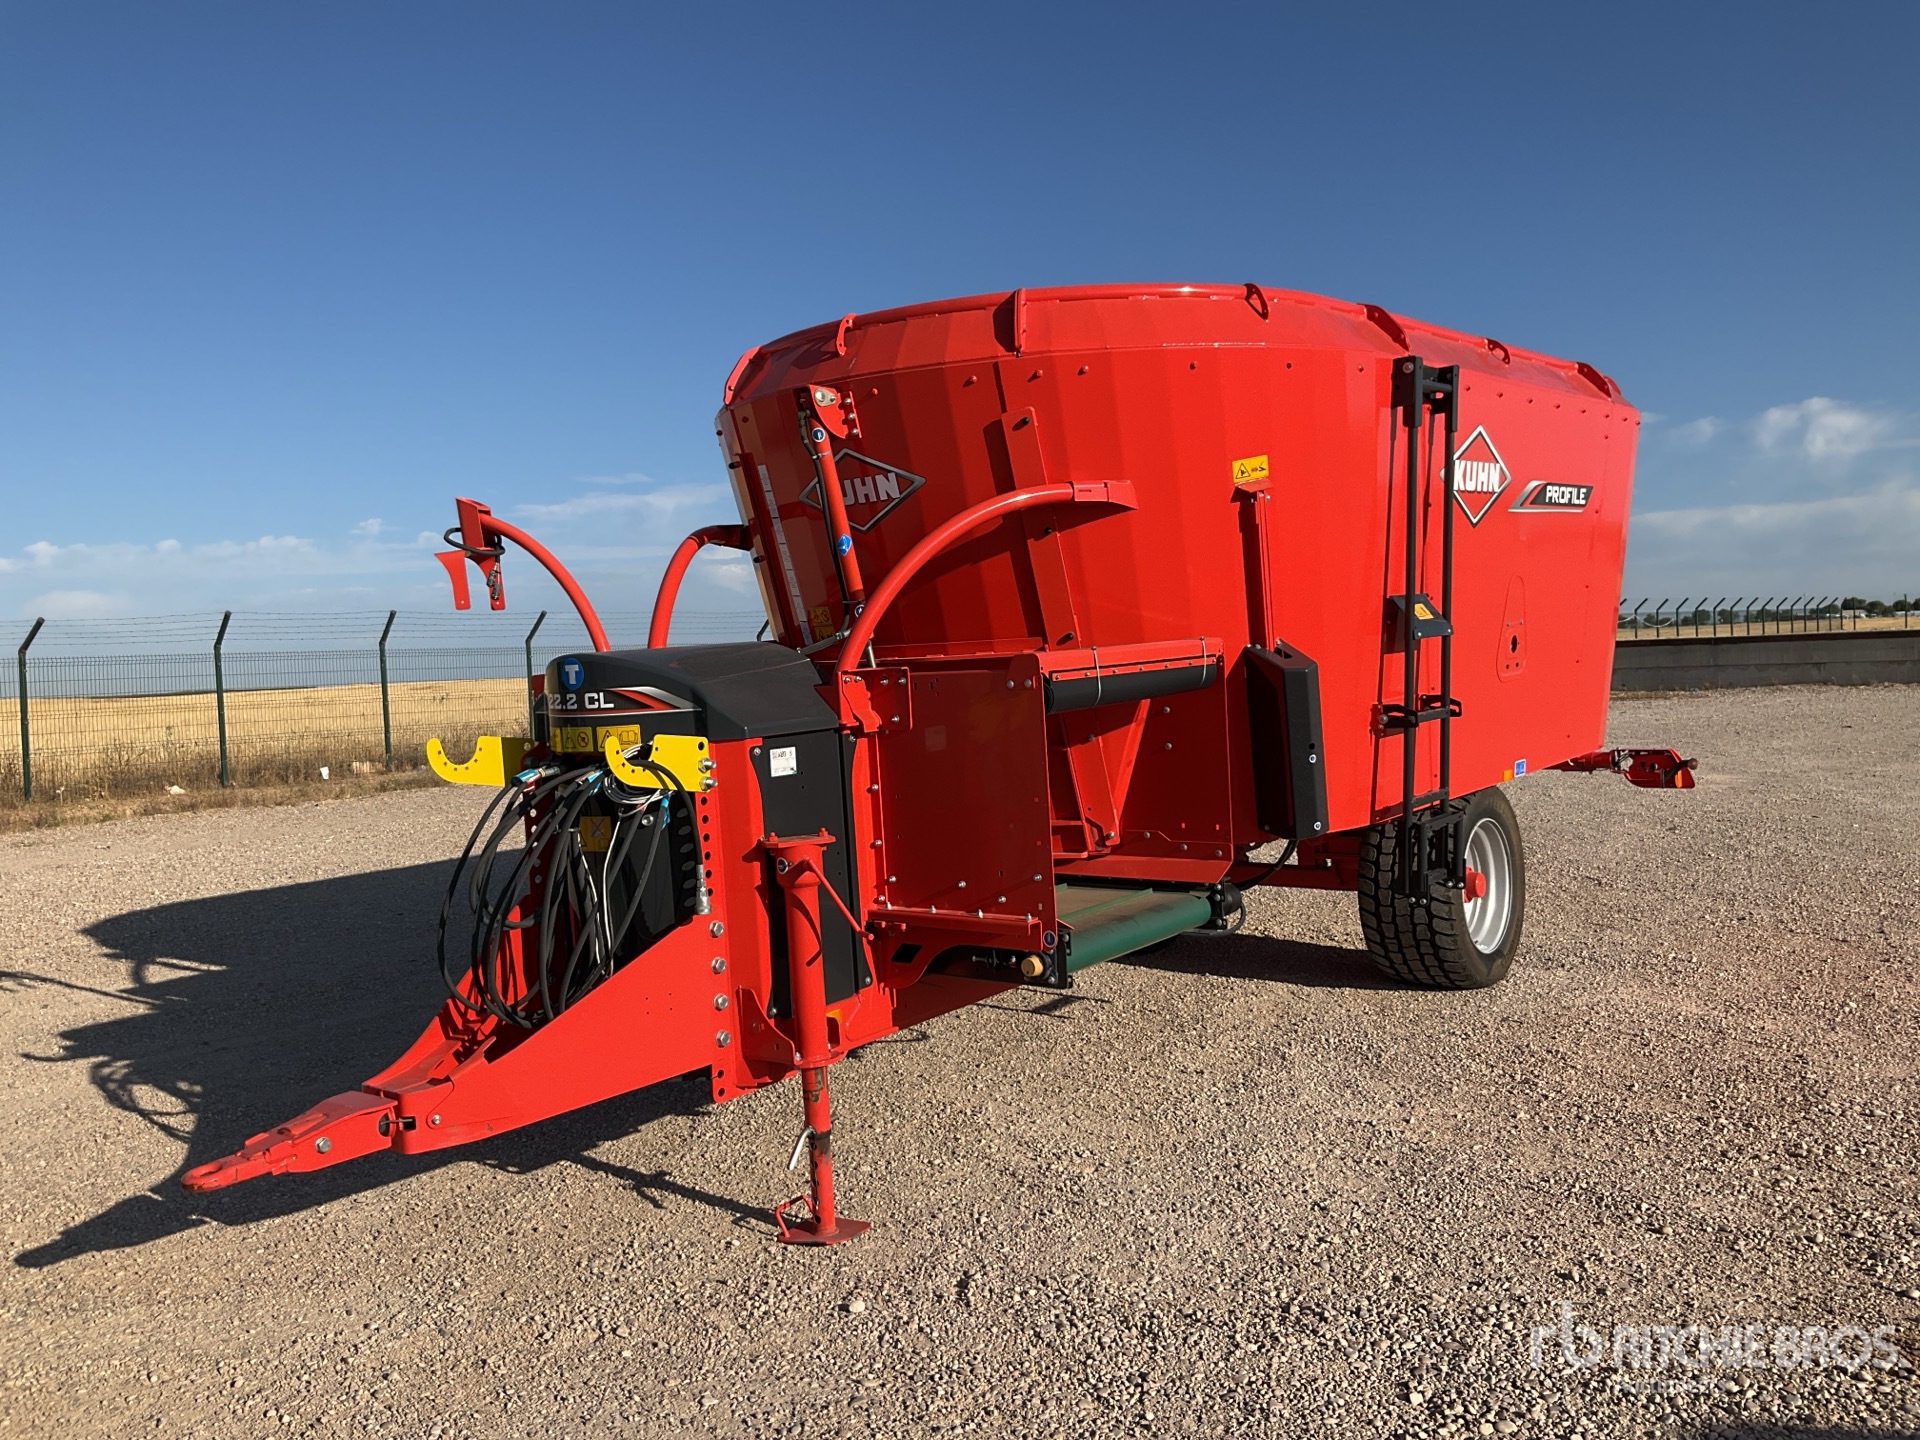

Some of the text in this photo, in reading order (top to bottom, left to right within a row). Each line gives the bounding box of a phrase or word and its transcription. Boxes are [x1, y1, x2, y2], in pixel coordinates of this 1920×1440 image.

[1453, 459, 1501, 493] KUHN
[816, 472, 901, 506] UHN
[1545, 485, 1587, 505] PROFILE
[564, 664, 579, 685] T
[584, 692, 615, 709] CL
